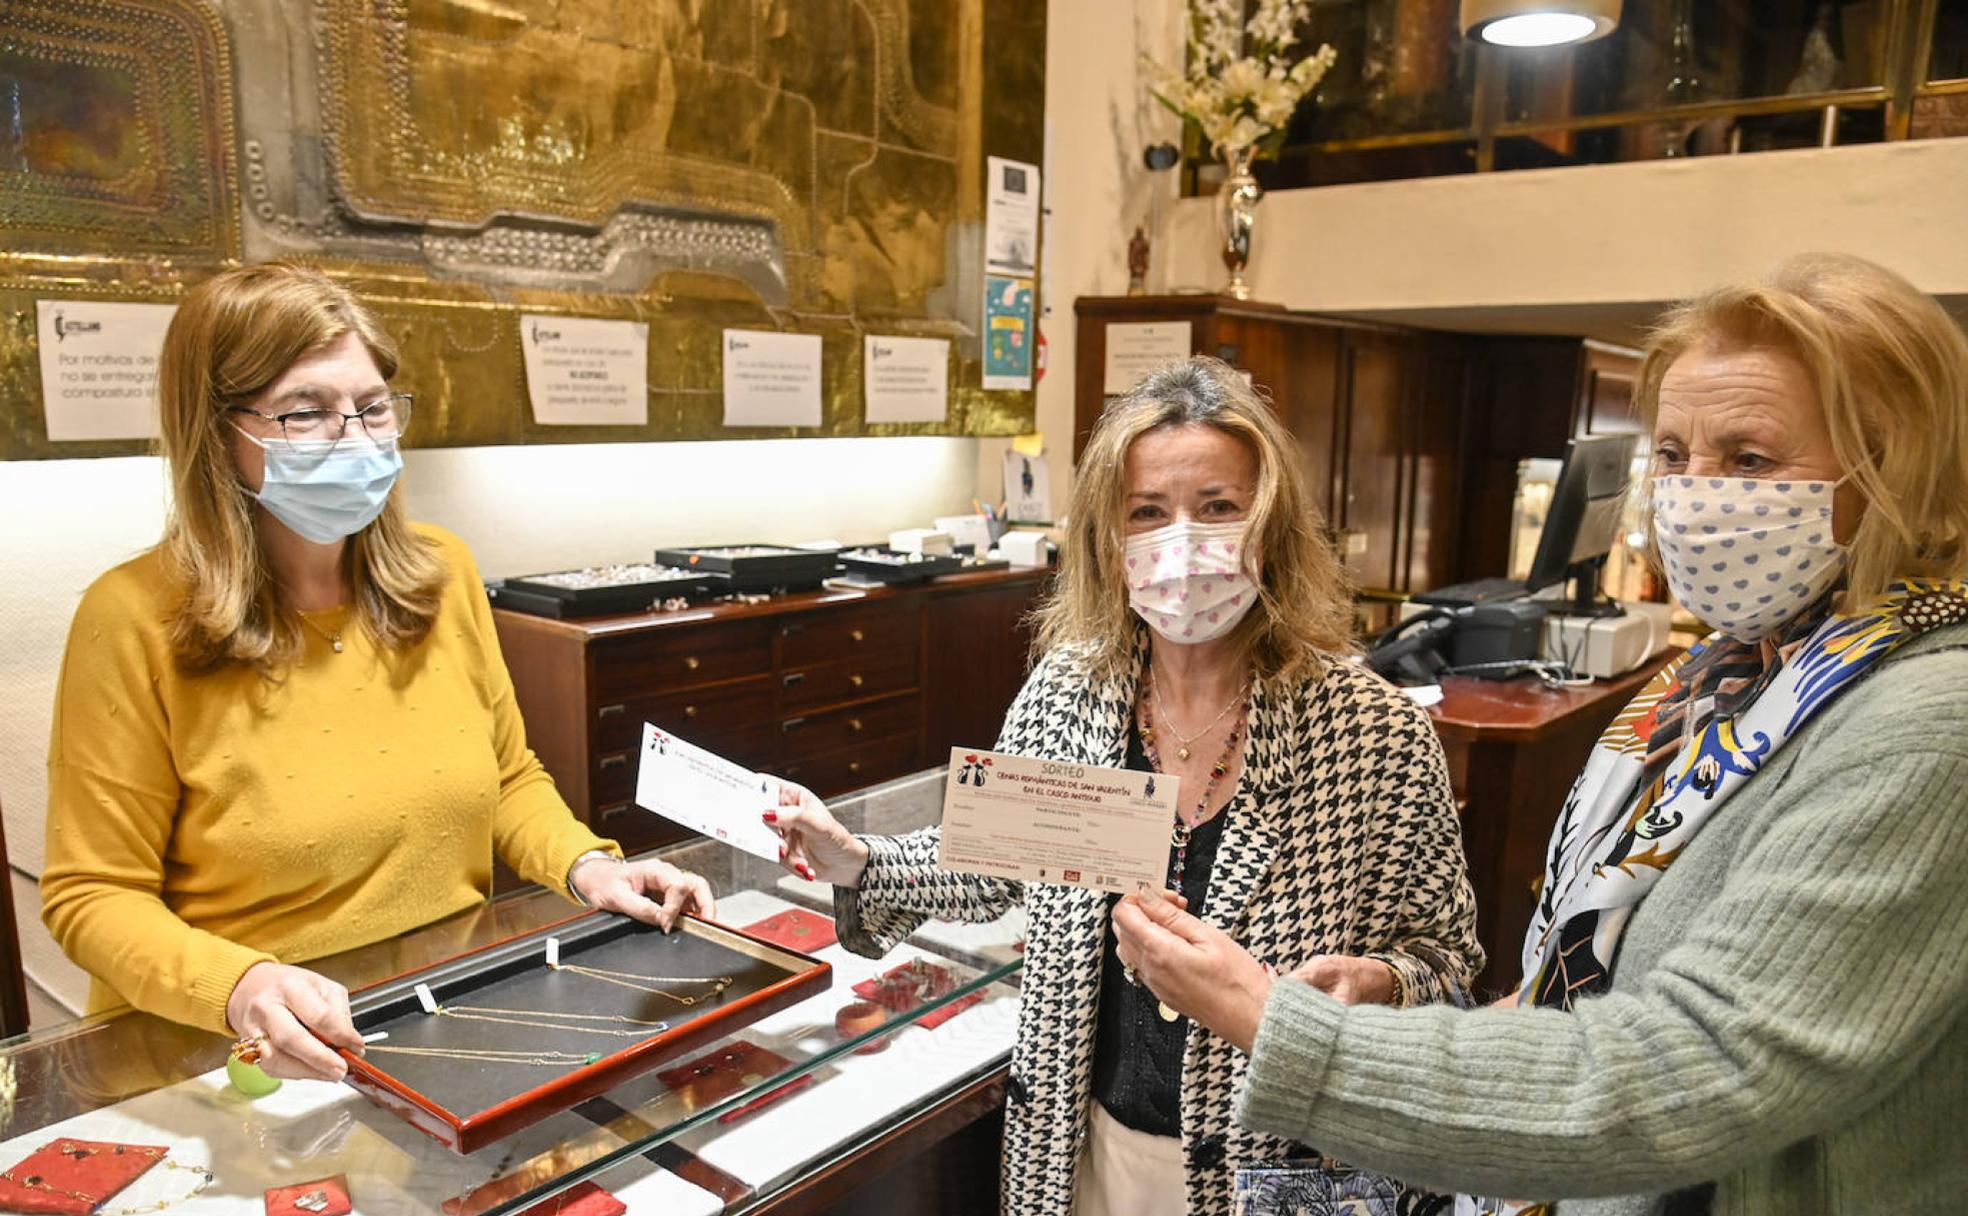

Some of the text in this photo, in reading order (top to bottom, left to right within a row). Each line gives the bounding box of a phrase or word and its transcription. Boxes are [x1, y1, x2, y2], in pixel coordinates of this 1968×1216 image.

[82, 353, 133, 365] motivos
[100, 371, 154, 384] entrega
[1041, 763, 1084, 779] SORTEO
[996, 771, 1131, 796] CENAS ROMÁNTICAS DE SAN VALENTÍN
[1022, 785, 1034, 793] EN
[1035, 787, 1046, 795] EL
[1046, 788, 1069, 799] CASCO
[1070, 792, 1102, 803] ANTIGUO
